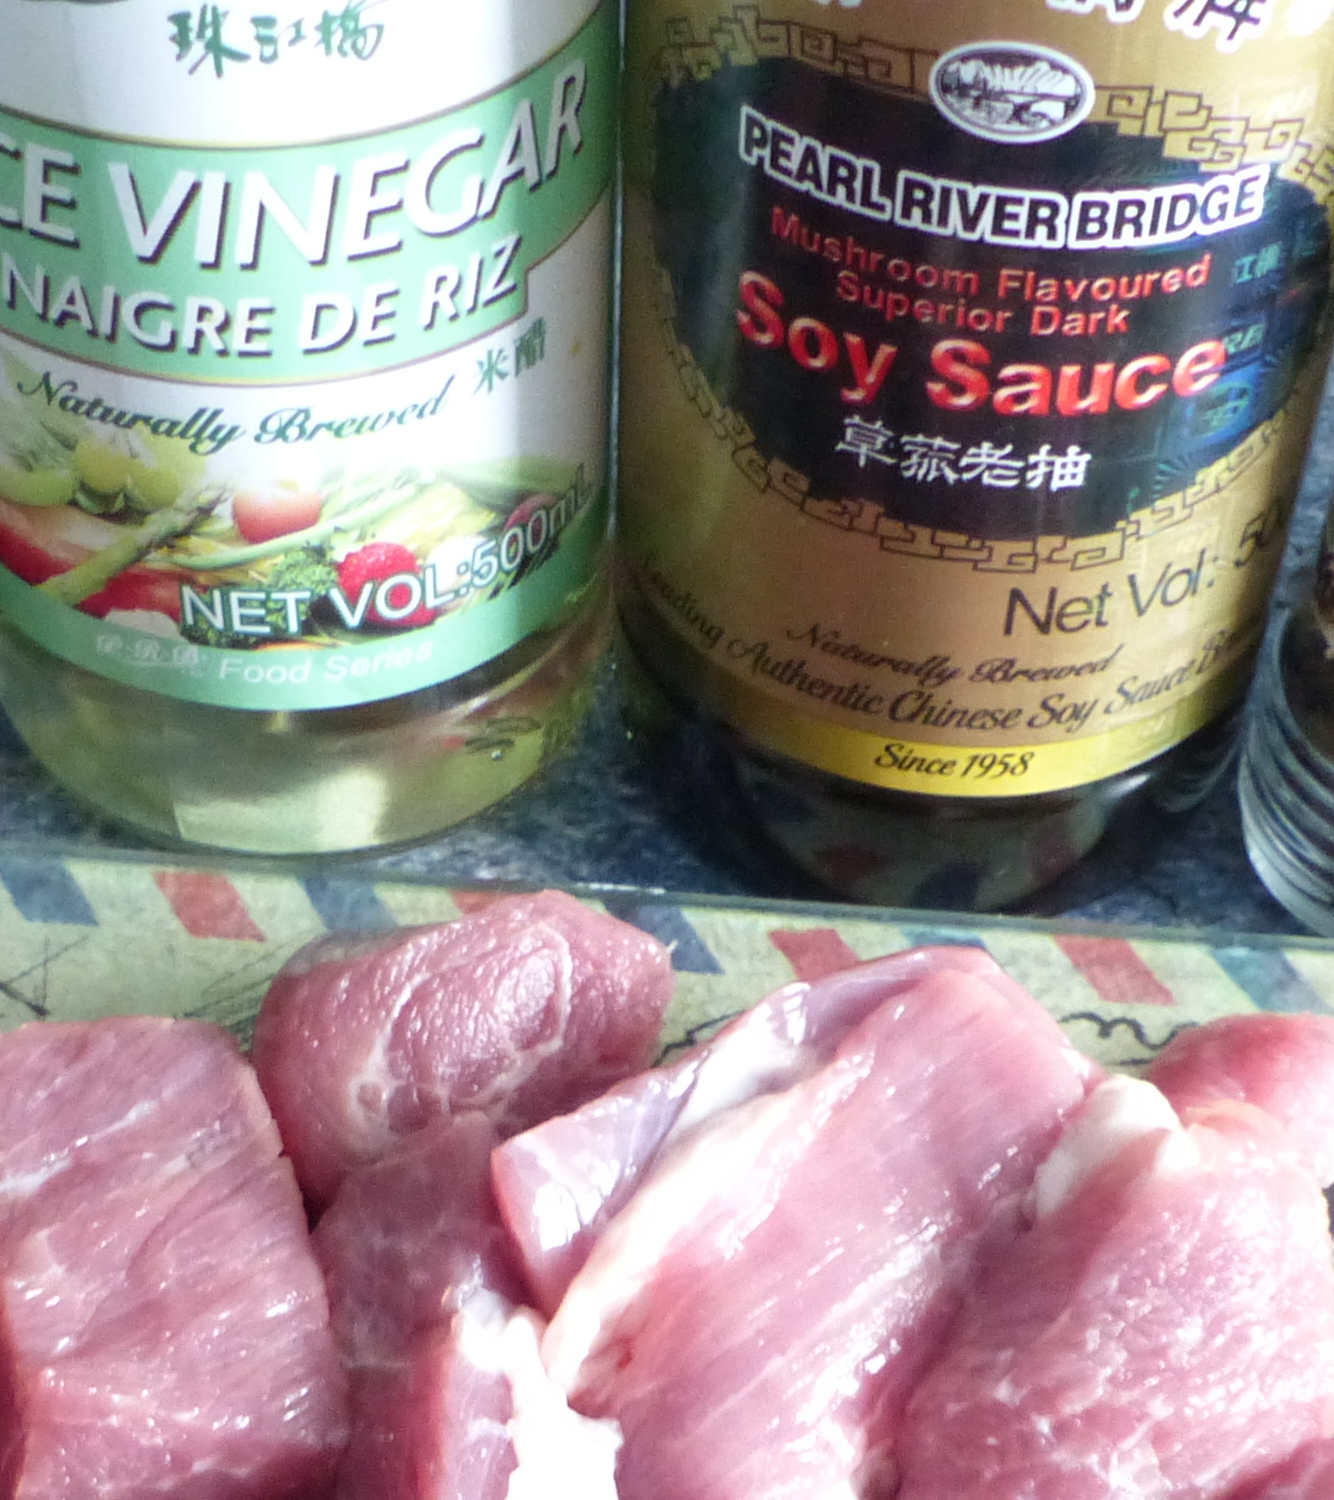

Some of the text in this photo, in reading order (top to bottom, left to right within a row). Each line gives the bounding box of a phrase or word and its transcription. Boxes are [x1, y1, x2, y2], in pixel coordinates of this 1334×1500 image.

[106, 59, 588, 270] VINEGAR
[738, 104, 1270, 248] PEARL RIVER BRIDGE
[297, 281, 401, 355] DE
[417, 232, 524, 330] RIZ
[770, 207, 979, 294] Mushroom
[997, 253, 1212, 303] Flavoured
[736, 270, 1229, 418] Soy Sauce
[836, 270, 1130, 337] Superior Dark
[17, 371, 457, 454] Naturally Brewed
[179, 583, 311, 638] NET
[1003, 584, 1112, 637] Net
[1128, 547, 1219, 617] Vol:
[219, 656, 311, 684] Food
[323, 640, 433, 677] Series
[727, 637, 884, 714] Authentic
[888, 691, 1023, 731] Chinese
[1028, 693, 1099, 733] Soy
[786, 623, 1124, 686] Naturally Brewed
[874, 743, 1036, 779] Since 1958
